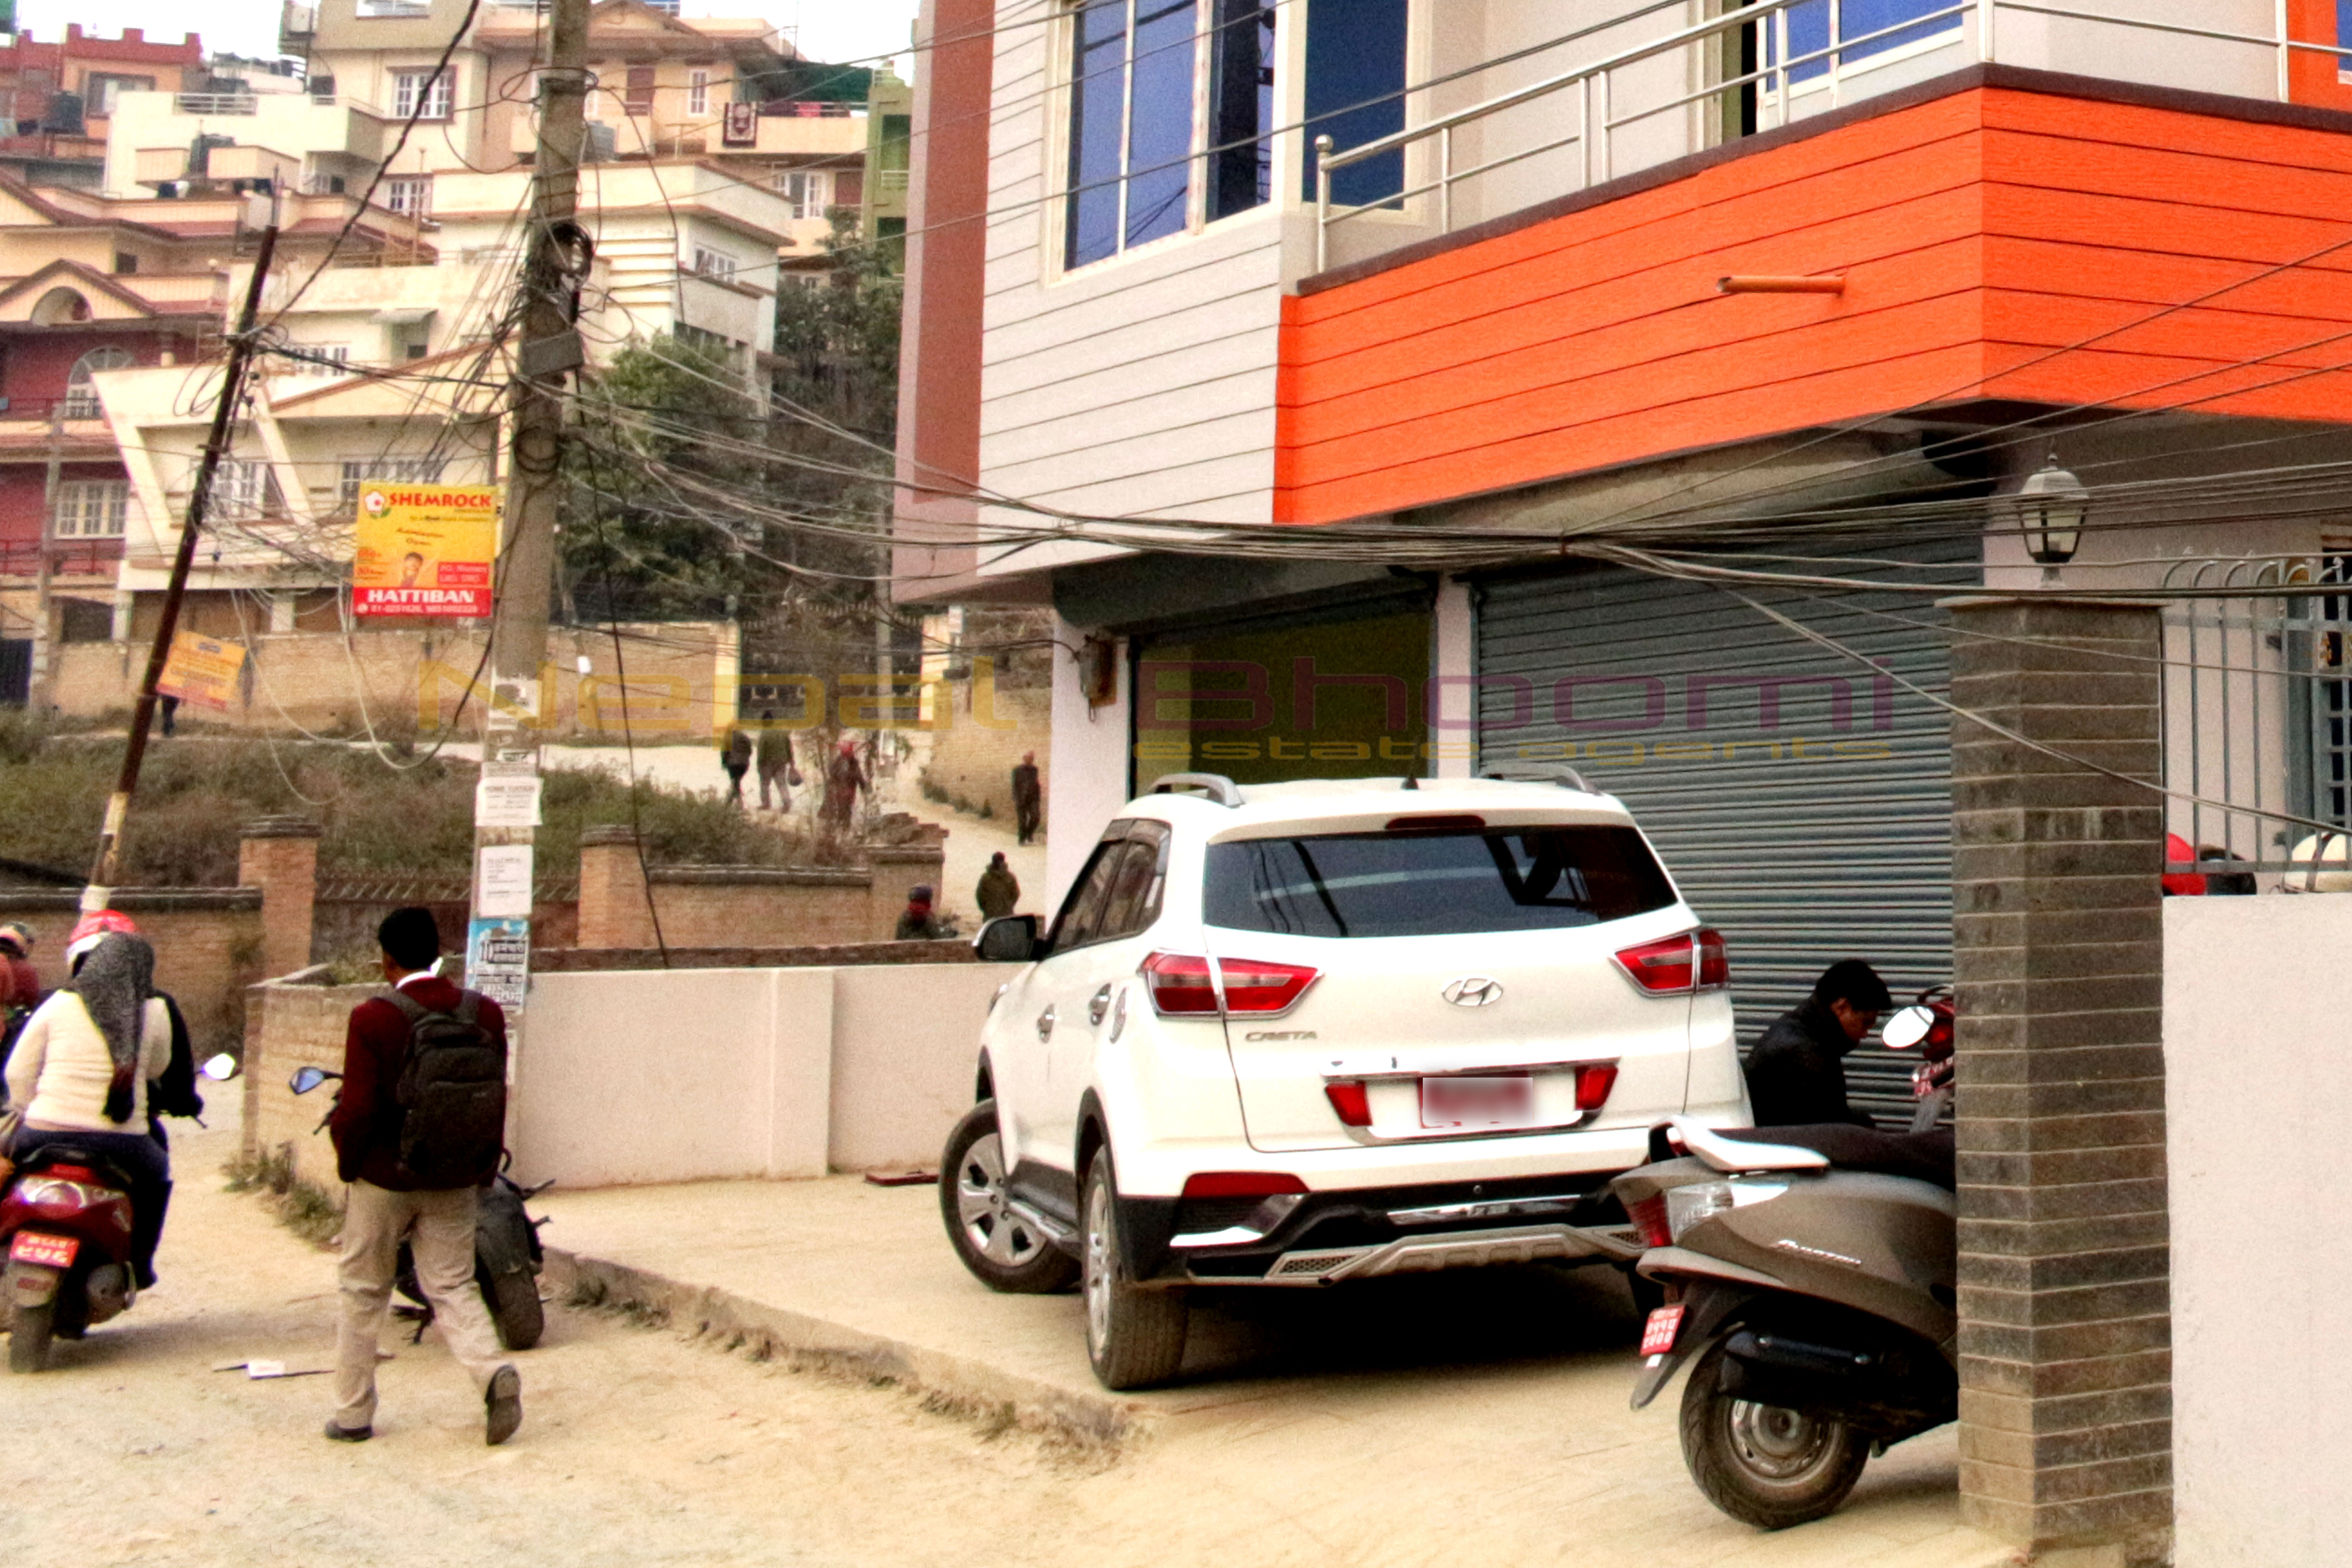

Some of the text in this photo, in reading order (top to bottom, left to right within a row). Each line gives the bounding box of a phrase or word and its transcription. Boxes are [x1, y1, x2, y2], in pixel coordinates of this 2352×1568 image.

[389, 493, 491, 507] SHEMROCK
[368, 589, 474, 603] HATTIBAN
[1245, 1030, 1318, 1042] CRETA
